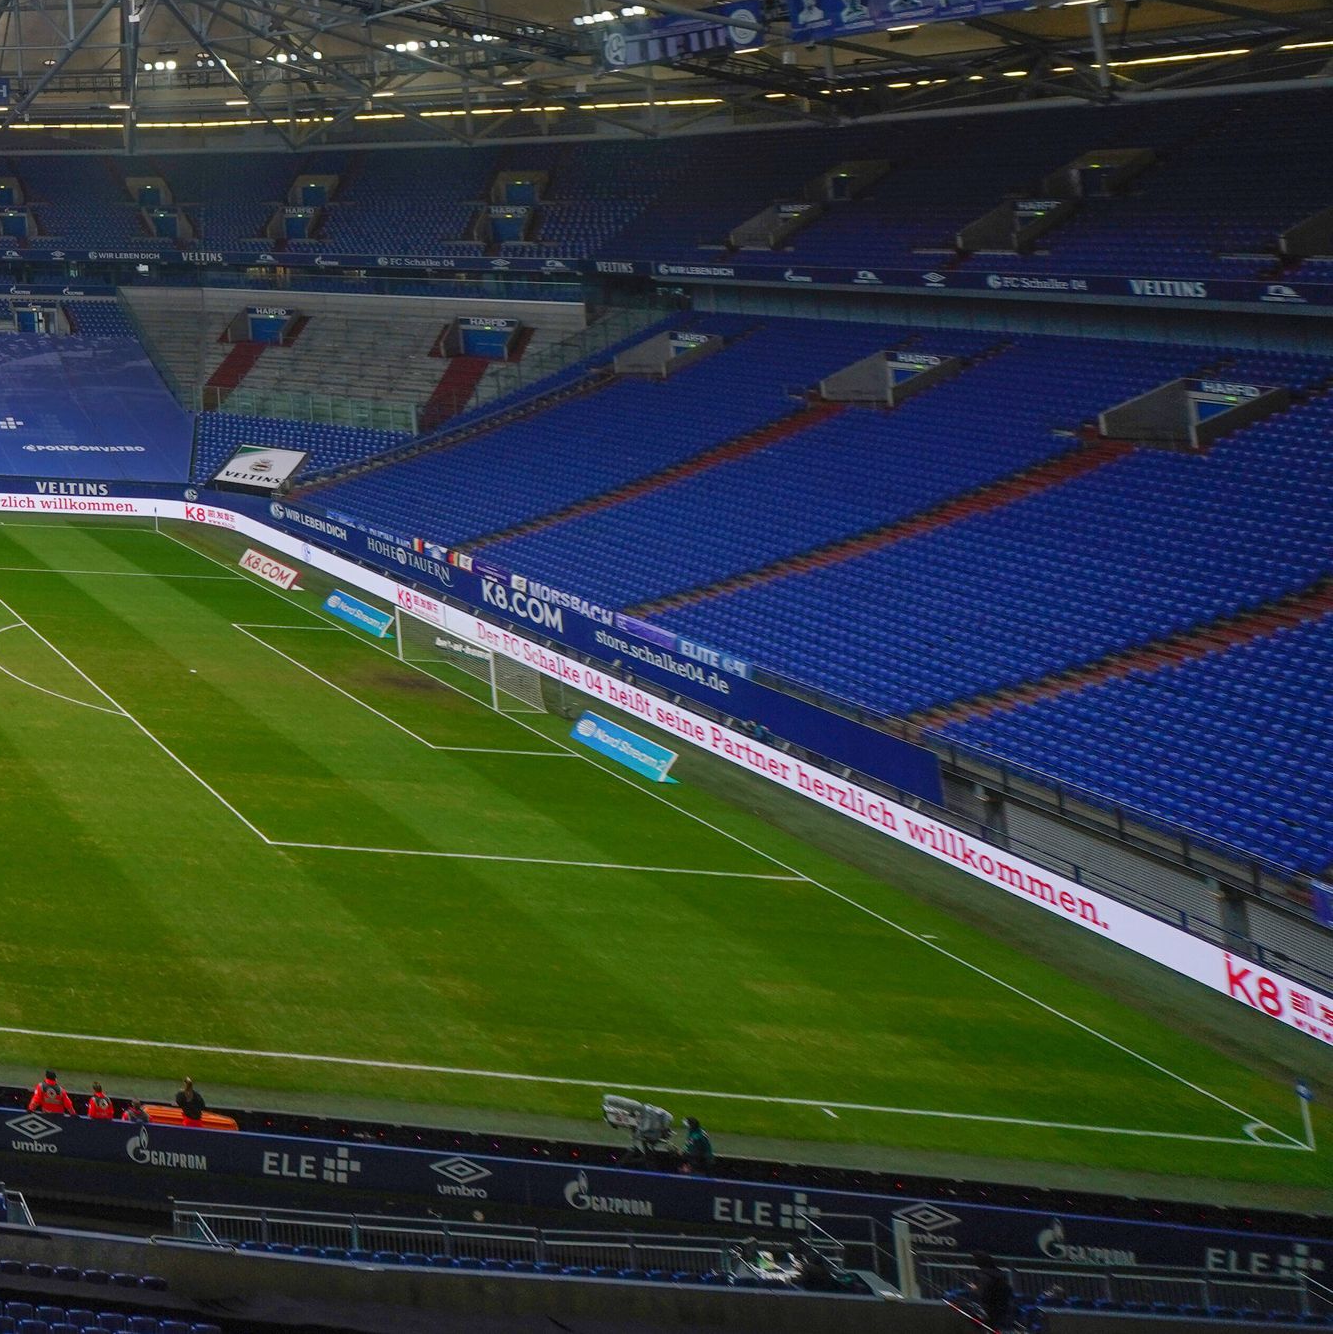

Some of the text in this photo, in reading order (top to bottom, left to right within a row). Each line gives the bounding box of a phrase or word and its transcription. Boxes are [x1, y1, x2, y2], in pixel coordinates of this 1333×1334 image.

[182, 252, 223, 262] VELTINS
[1130, 279, 1207, 298] VELTINS
[36, 444, 145, 452] POLYGONVATRO
[36, 481, 108, 495] VELTINS
[225, 471, 280, 484] VELTINS
[40, 498, 138, 512] willkommen.
[185, 503, 206, 522] K8
[285, 508, 302, 524] WIR
[302, 512, 325, 533] LEBEN
[326, 523, 347, 541] DICH
[244, 553, 291, 586] K8.COM
[367, 537, 396, 559] HOHE
[408, 551, 453, 587] TAUERN
[482, 578, 563, 633] K8.COM
[595, 629, 730, 694] store.schalke04.de
[595, 727, 614, 749] Nord
[615, 738, 656, 769] Stream
[476, 622, 1109, 930] Der FC Schalke 04 heißt seine Partner herzlich willkommen.
[1223, 953, 1284, 1017] K8
[12, 1141, 58, 1154] umbro
[151, 1151, 207, 1170] GAZPROM
[263, 1151, 317, 1179] ELE
[437, 1183, 487, 1199] umbro
[713, 1197, 773, 1226] ELE
[1206, 1248, 1270, 1273] ELE
